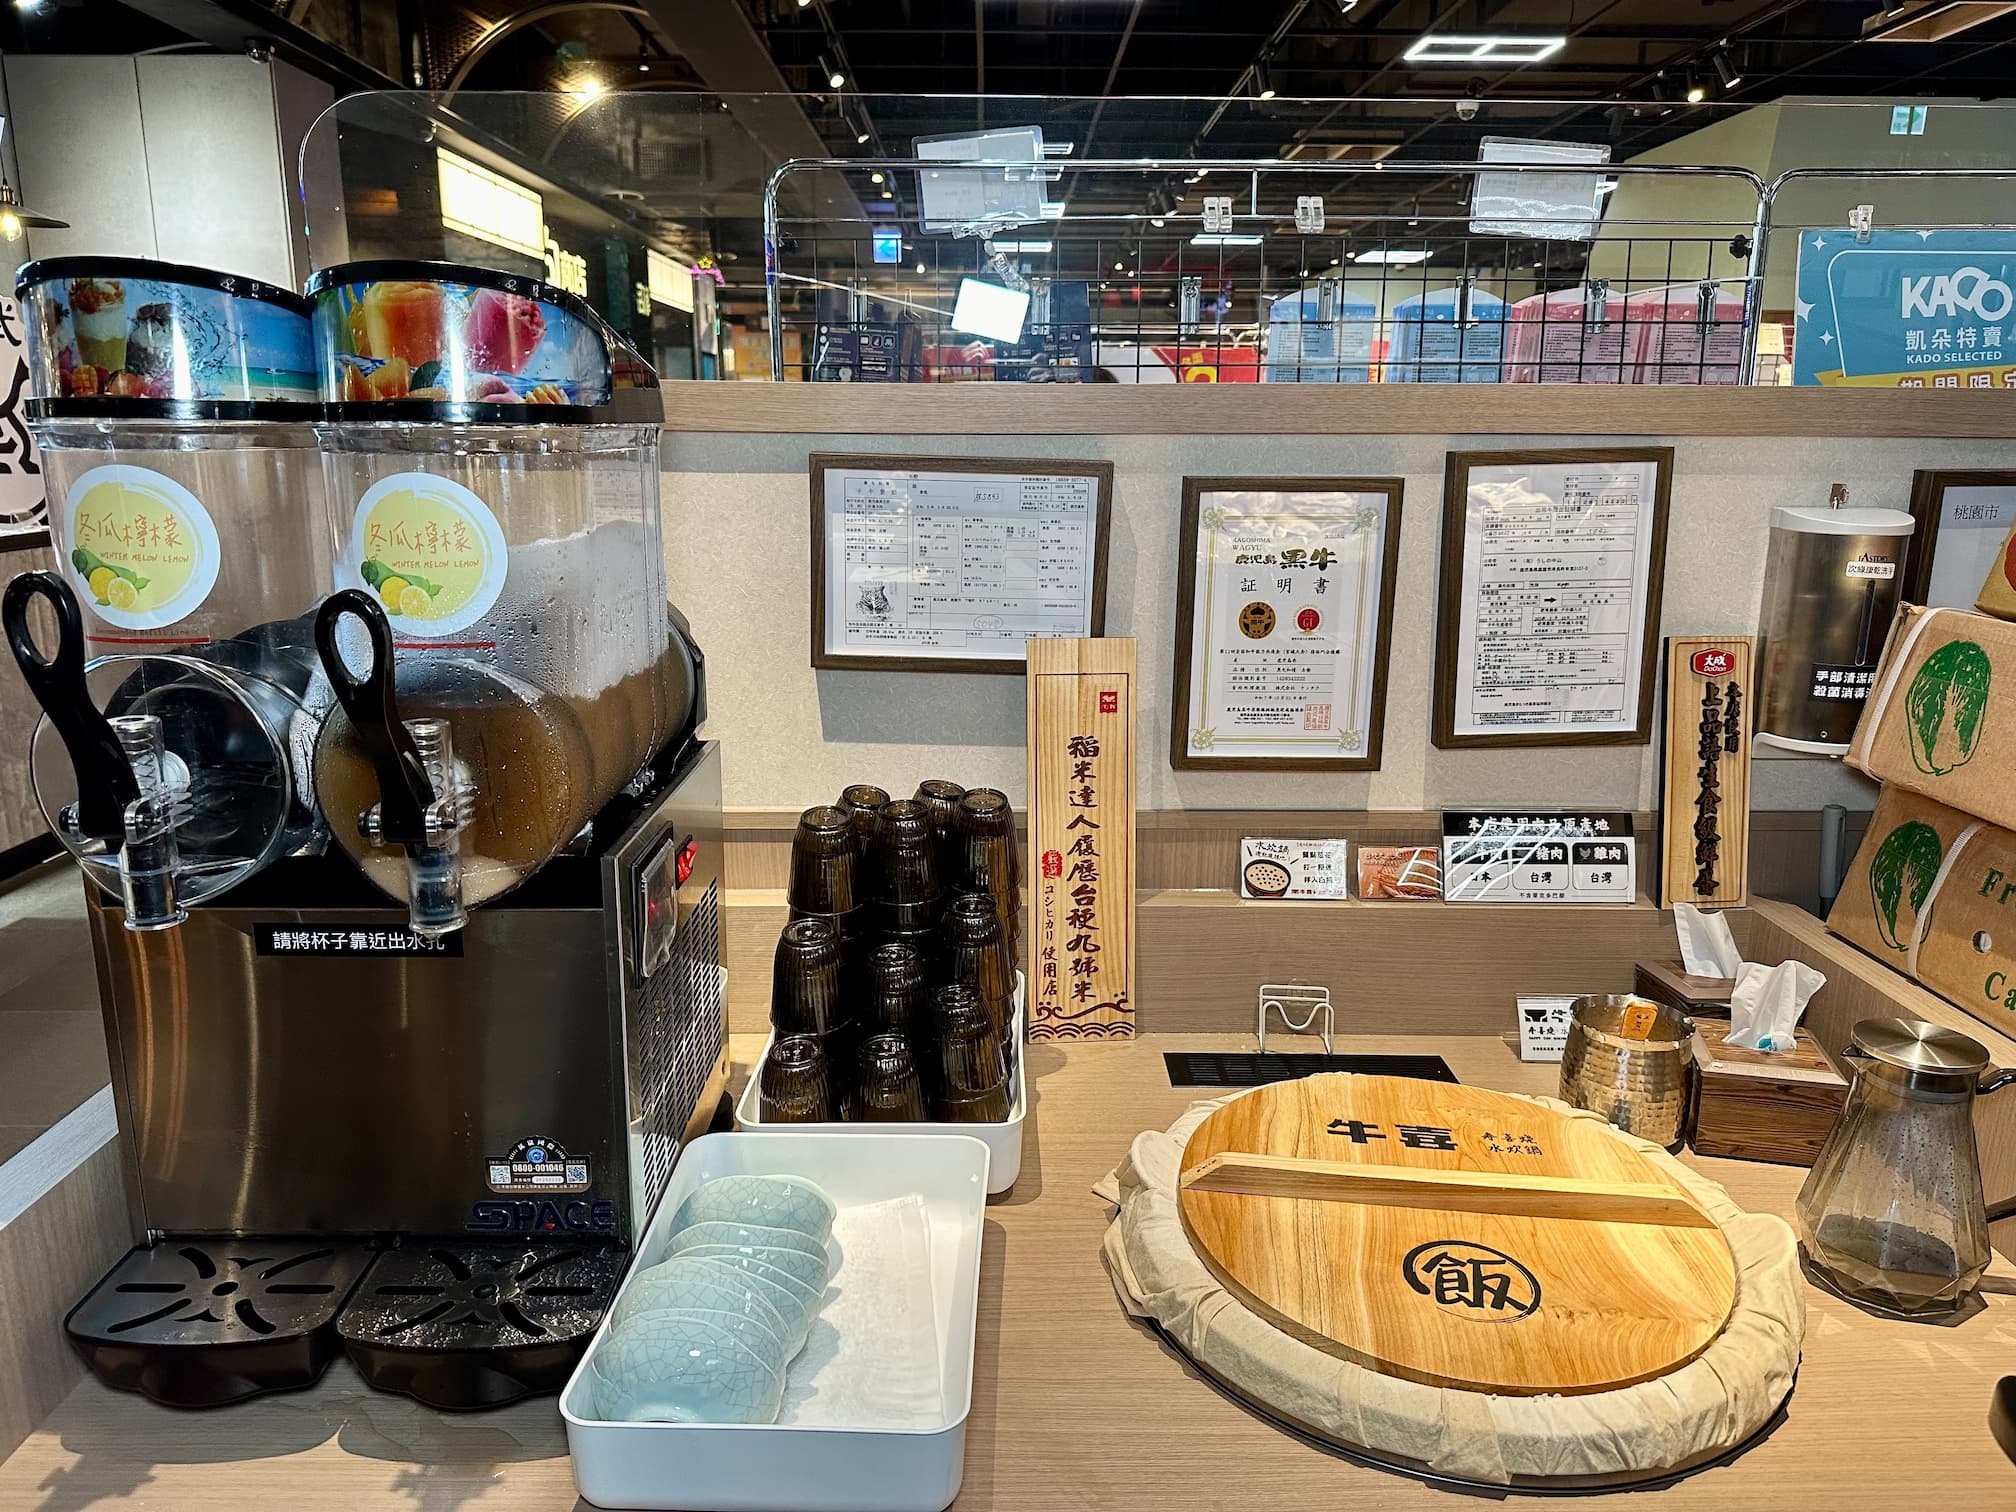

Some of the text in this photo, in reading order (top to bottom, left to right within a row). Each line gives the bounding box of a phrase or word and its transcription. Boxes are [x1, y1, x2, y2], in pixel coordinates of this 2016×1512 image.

[1905, 326, 2002, 351] 凱朵特賣
[1906, 351, 2002, 364] KADO SELECTED
[1953, 504, 1999, 520] 桃園市
[79, 512, 183, 548] 冬瓜檸檬
[370, 519, 472, 555] 冬瓜檸檬
[101, 552, 190, 563] WINTER MELON LEMON
[392, 560, 480, 569] WINTER MELON LEMON
[1240, 577, 1330, 595] 証明書
[1530, 871, 1552, 883] 台灣
[1590, 871, 1612, 883] 台灣
[272, 931, 445, 950] 請將杯子靠近出水孔
[464, 1200, 616, 1231] SPACE
[1421, 1252, 1529, 1312] 飯
